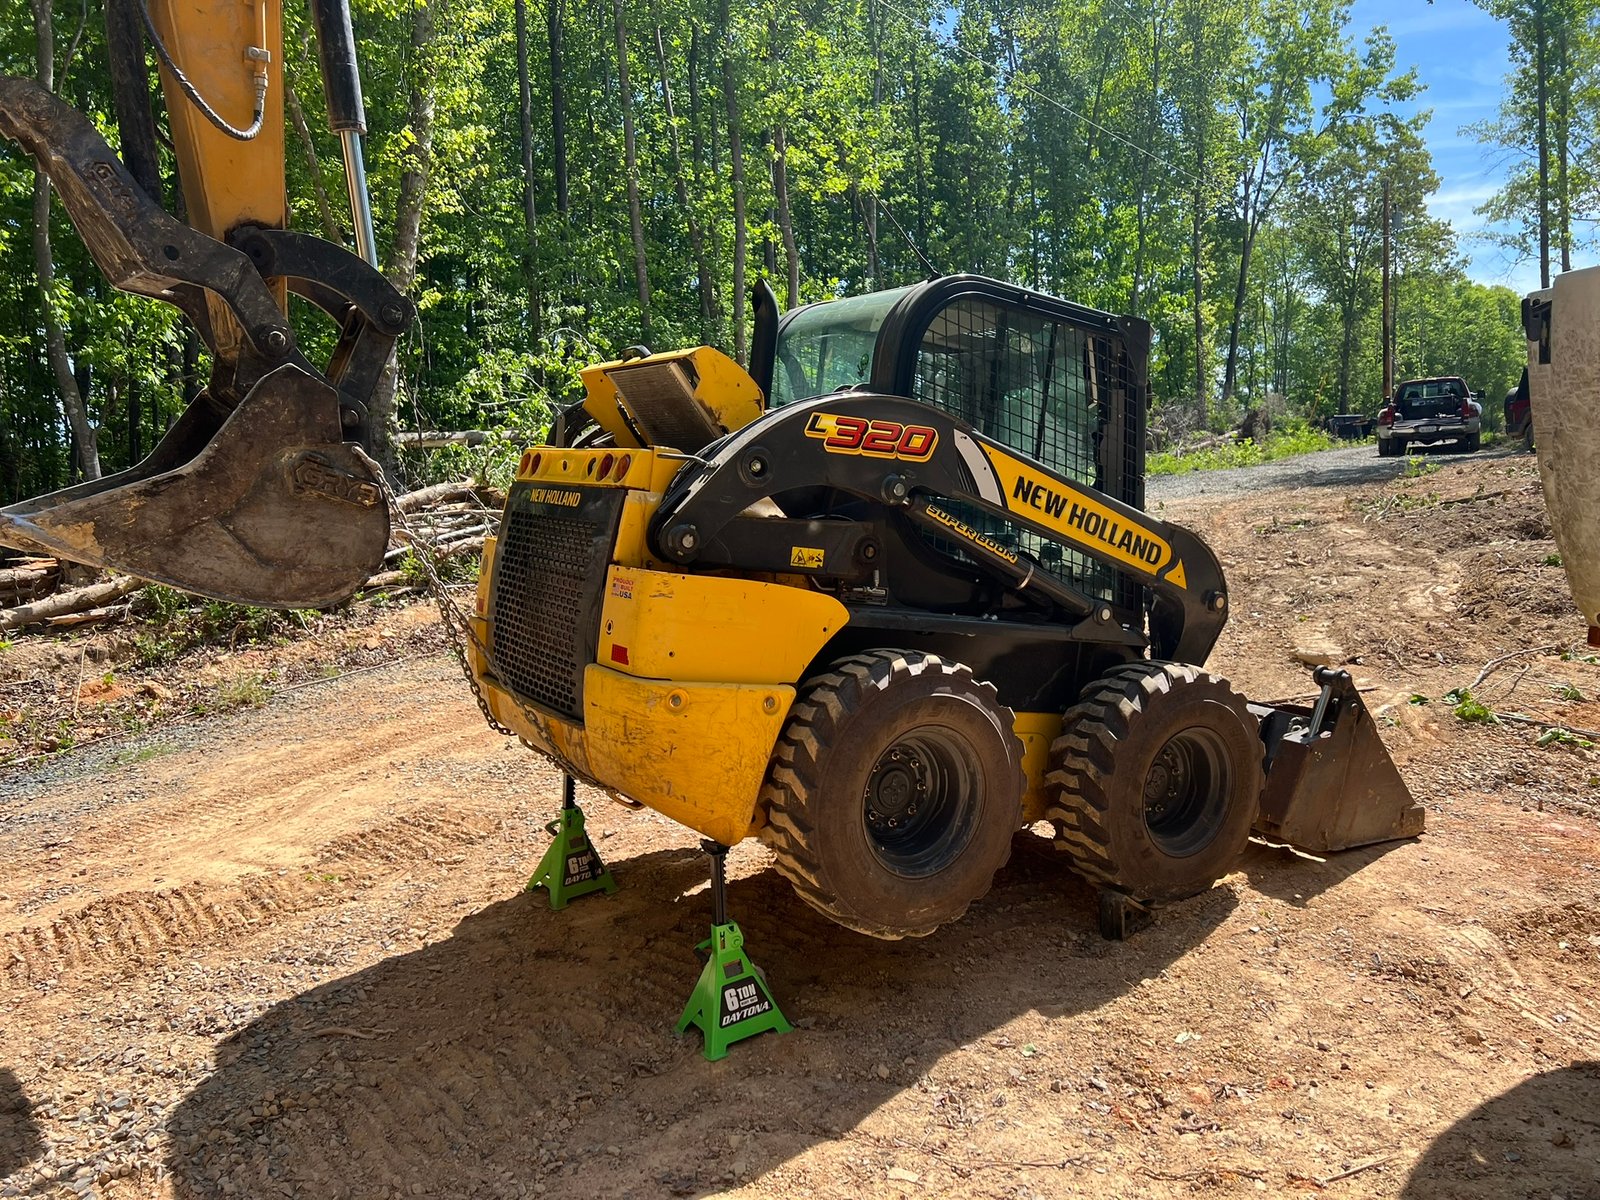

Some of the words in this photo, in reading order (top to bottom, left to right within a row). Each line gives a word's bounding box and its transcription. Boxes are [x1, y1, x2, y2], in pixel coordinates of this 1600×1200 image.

[805, 412, 938, 462] L320
[530, 488, 547, 503] NEW
[545, 489, 581, 507] HOLLAND
[1012, 475, 1068, 519] NEW
[1067, 503, 1162, 566] HOLLAND
[926, 504, 977, 540] SUPER
[975, 533, 1018, 564] BOOM
[619, 591, 632, 600] USA
[564, 867, 602, 886] DAYTOA
[567, 857, 579, 875] 6
[724, 988, 740, 1012] 6
[736, 983, 757, 1000] TON
[721, 1000, 769, 1026] DAYTONA
